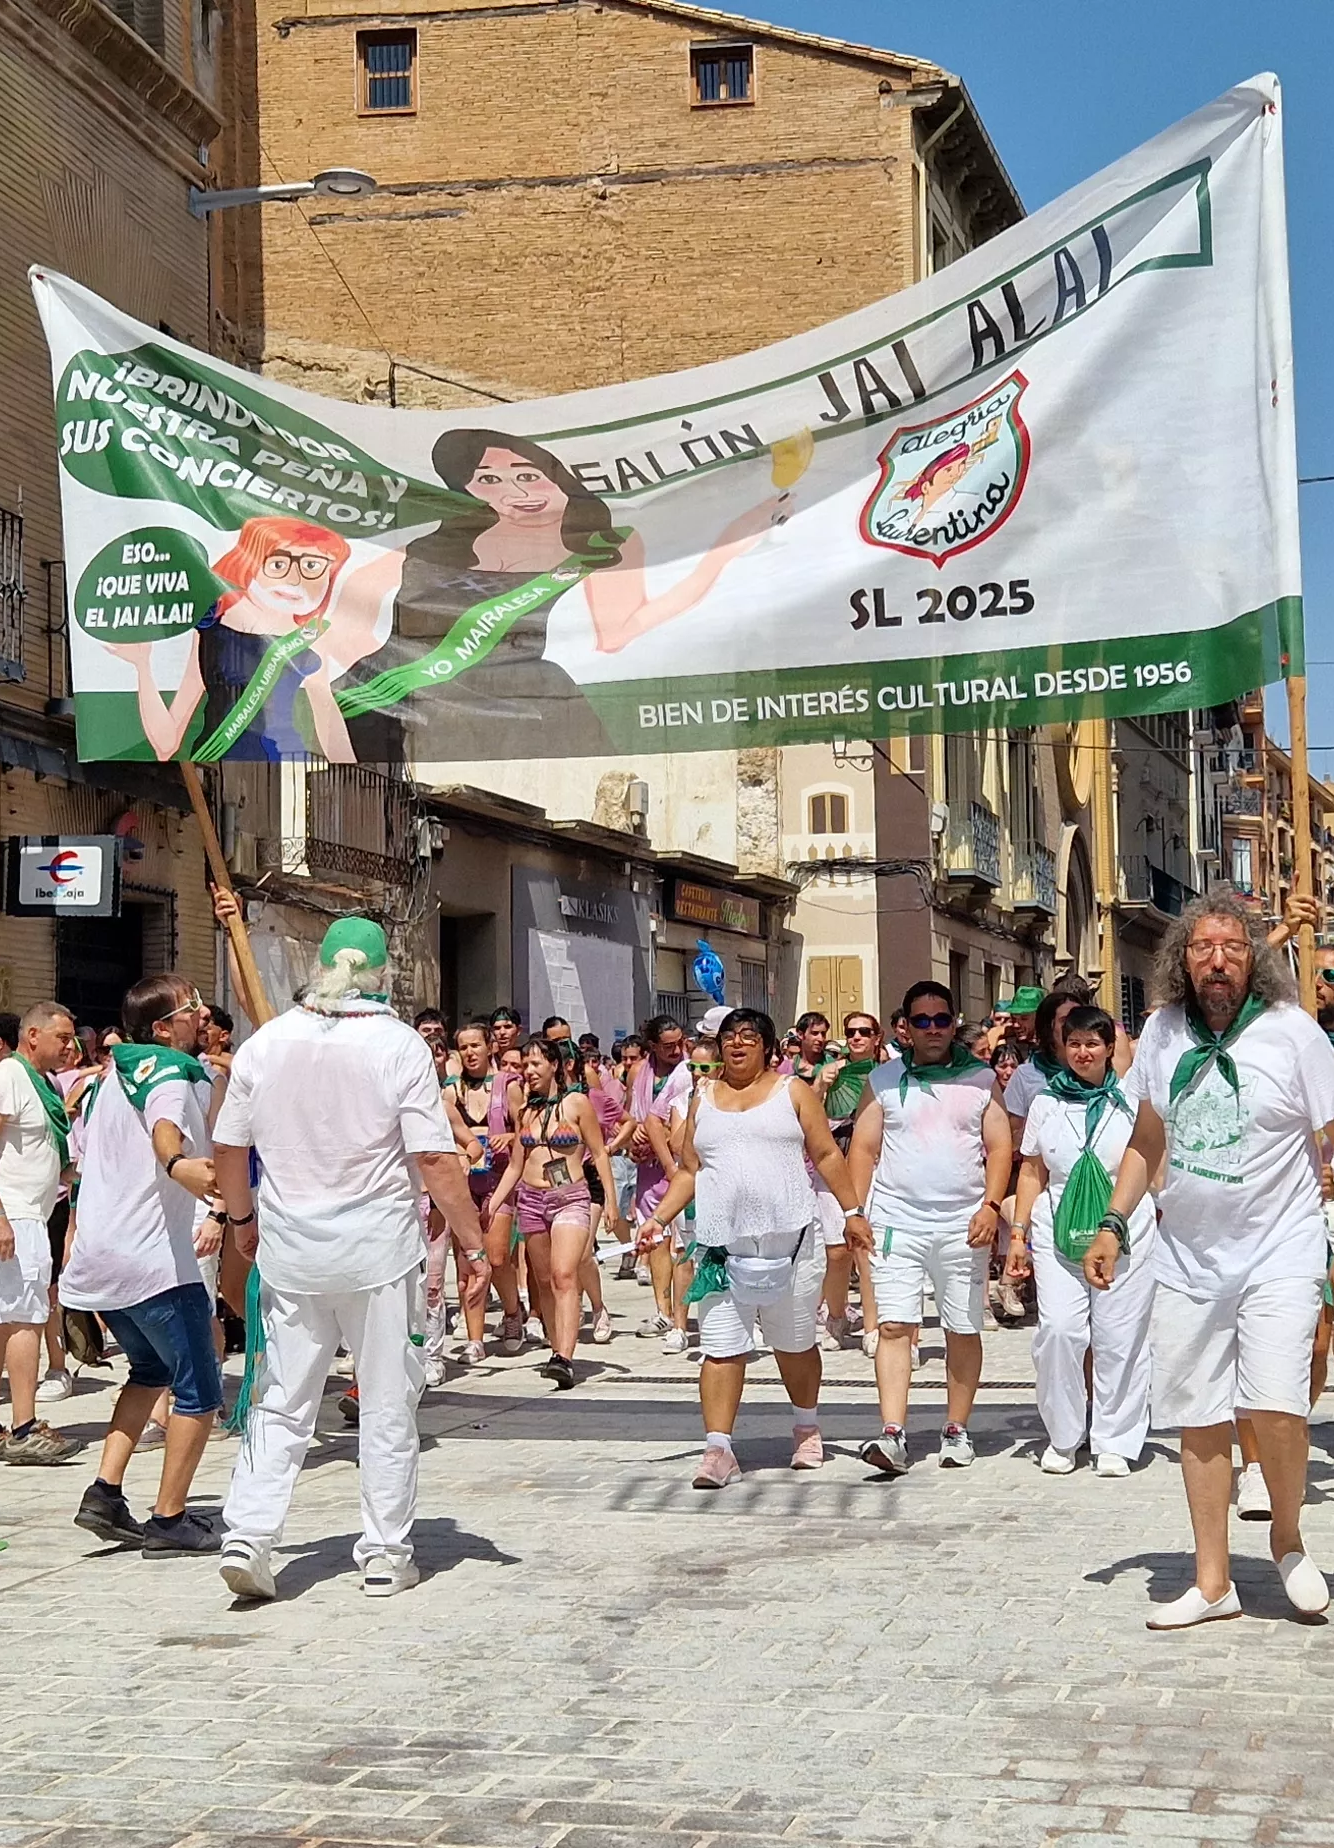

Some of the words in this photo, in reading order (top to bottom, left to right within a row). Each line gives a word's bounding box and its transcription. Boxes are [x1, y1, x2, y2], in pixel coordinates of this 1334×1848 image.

[570, 419, 764, 493] SALÓN
[817, 339, 926, 423] JAI
[966, 224, 1113, 373] ALAI
[67, 369, 241, 456] NUESTRA
[251, 449, 369, 498] PEÑA
[381, 474, 410, 503] Y
[273, 425, 360, 464] POR
[60, 418, 114, 456] SUS
[119, 426, 396, 530] CONCIERTOS!
[875, 471, 1011, 546] Laurentina
[121, 541, 171, 565] ESO...
[96, 574, 142, 599] ¡QUE
[145, 570, 190, 594] VIVA
[849, 586, 903, 631] SL
[916, 579, 1035, 625] 2025
[84, 607, 108, 628] EL
[112, 605, 141, 629] JAI
[143, 603, 195, 626] ALAI!
[421, 659, 453, 680] YO
[454, 586, 551, 661] MAIRALESA
[224, 685, 265, 740] MAIRALESA
[260, 637, 305, 687] URBANISMO
[638, 701, 704, 729] BIEN
[711, 698, 750, 724] DE
[757, 684, 869, 721] INTERÉS
[876, 675, 1028, 710] CULTURAL
[1033, 664, 1128, 697] DESDE
[1133, 660, 1192, 688] 1956
[35, 887, 85, 900] Ibeaja
[675, 899, 718, 922] RESTAURANTE
